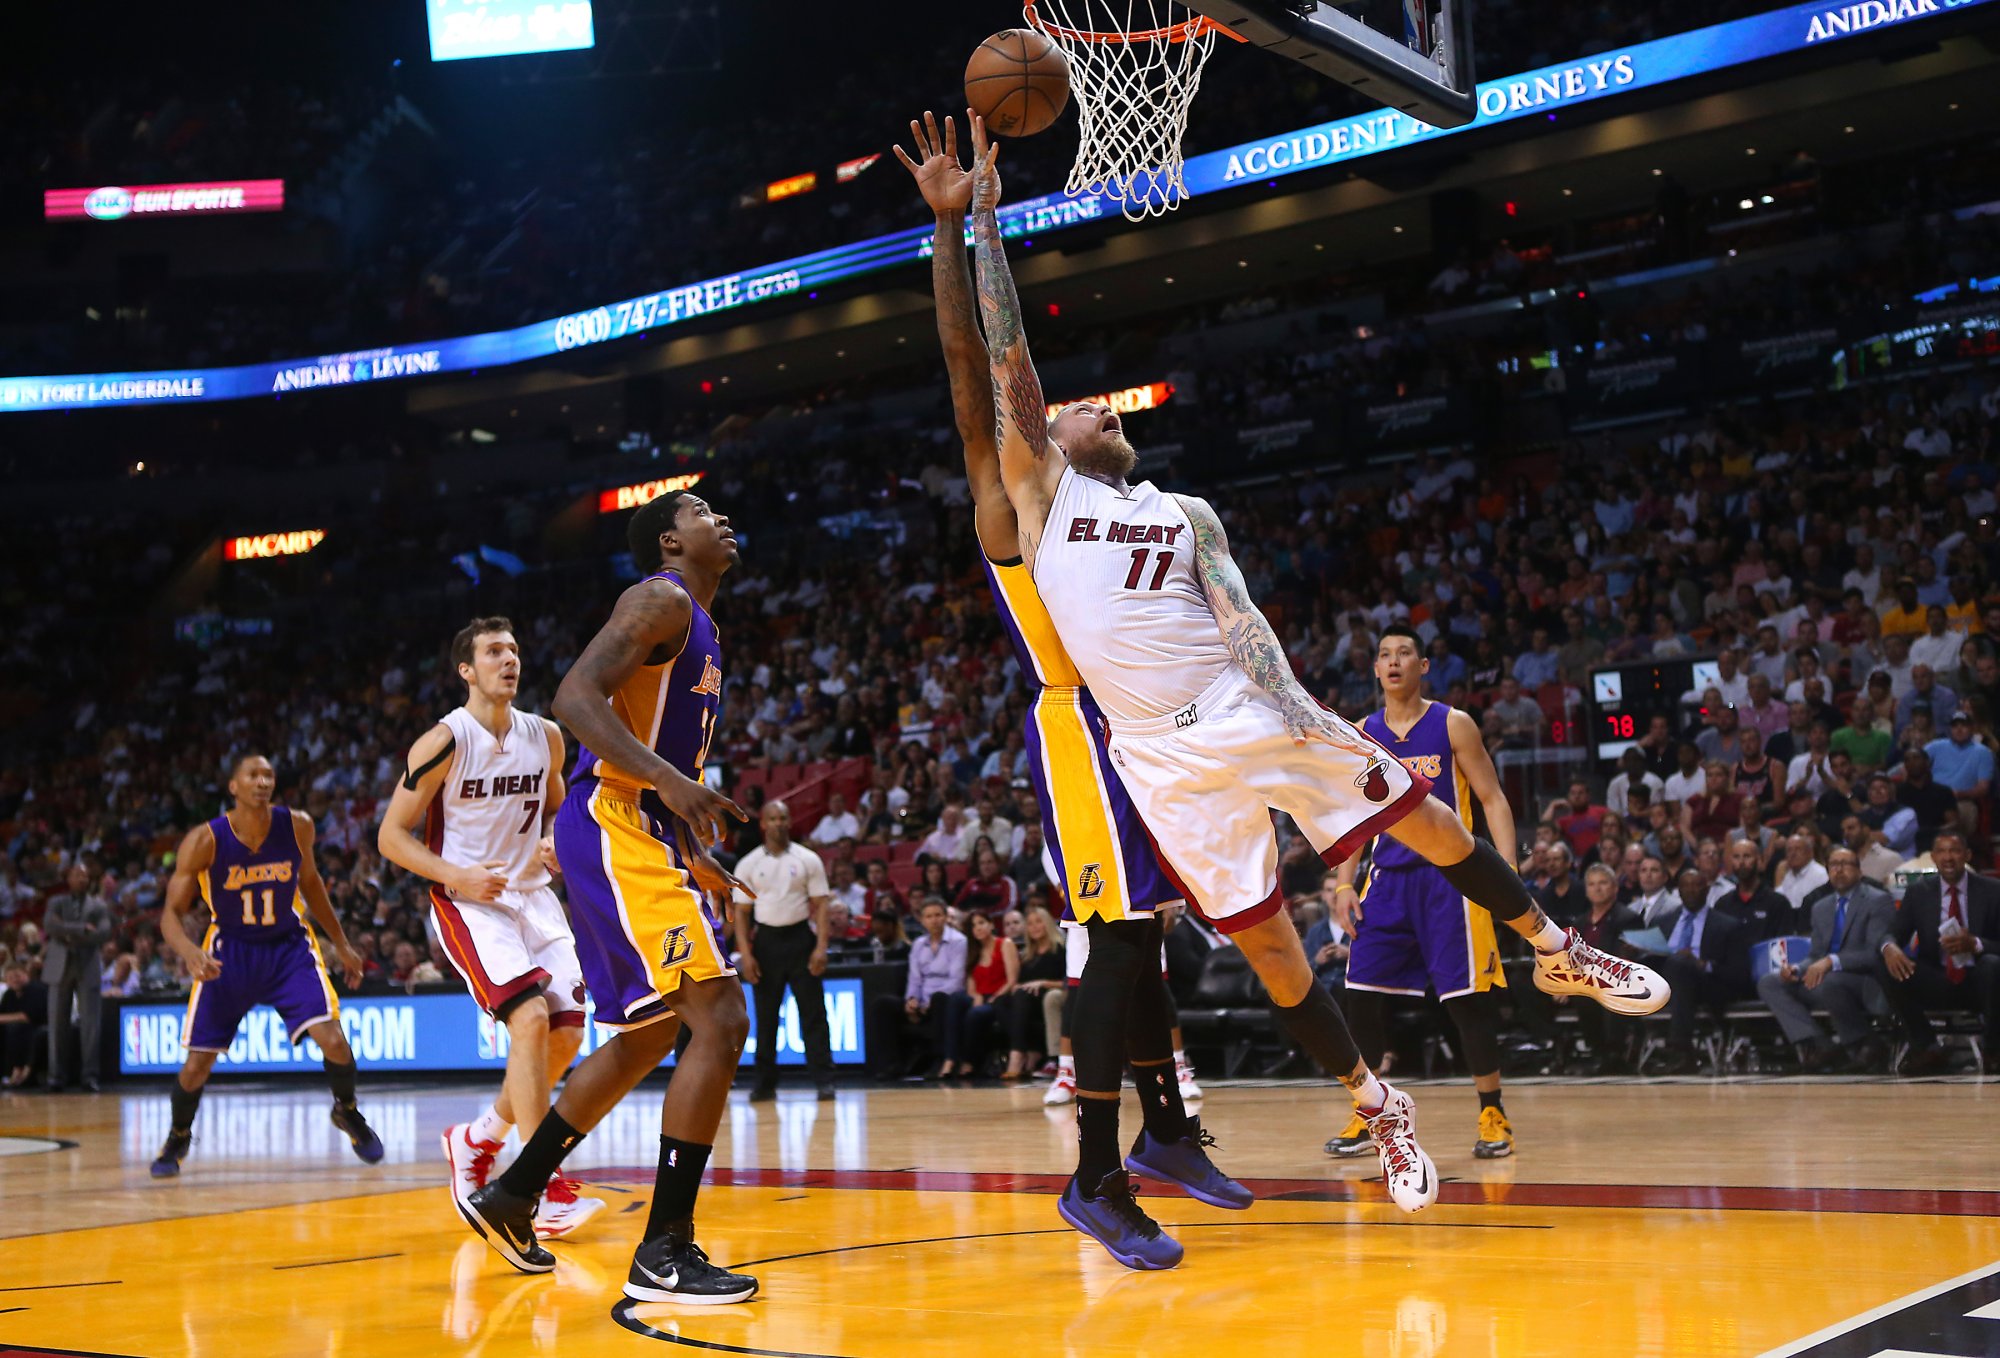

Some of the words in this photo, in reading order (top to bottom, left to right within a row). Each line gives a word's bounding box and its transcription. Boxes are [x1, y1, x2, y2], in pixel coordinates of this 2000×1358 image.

[1223, 113, 1401, 181] ACCIDENT
[1409, 54, 1635, 135] AORNEYS
[132, 191, 172, 212] SUN
[170, 188, 244, 211] SPORTS
[1024, 195, 1103, 231] LEVINE
[554, 305, 612, 352] (800)
[611, 275, 744, 339] 747-FREE
[372, 350, 441, 379] LEVINE
[88, 377, 205, 400] LAUDERDALE
[1046, 385, 1153, 421] BARDI
[1067, 517, 1101, 543] EL
[1105, 520, 1186, 546] HEAT
[1123, 547, 1175, 591] 11
[1607, 714, 1635, 738] 78
[460, 778, 488, 799] EL
[492, 766, 544, 797] HEAT
[518, 799, 540, 834] 7
[223, 860, 293, 891] LAKERS
[240, 887, 277, 926] 11
[140, 1005, 416, 1065] NBCKECOM
